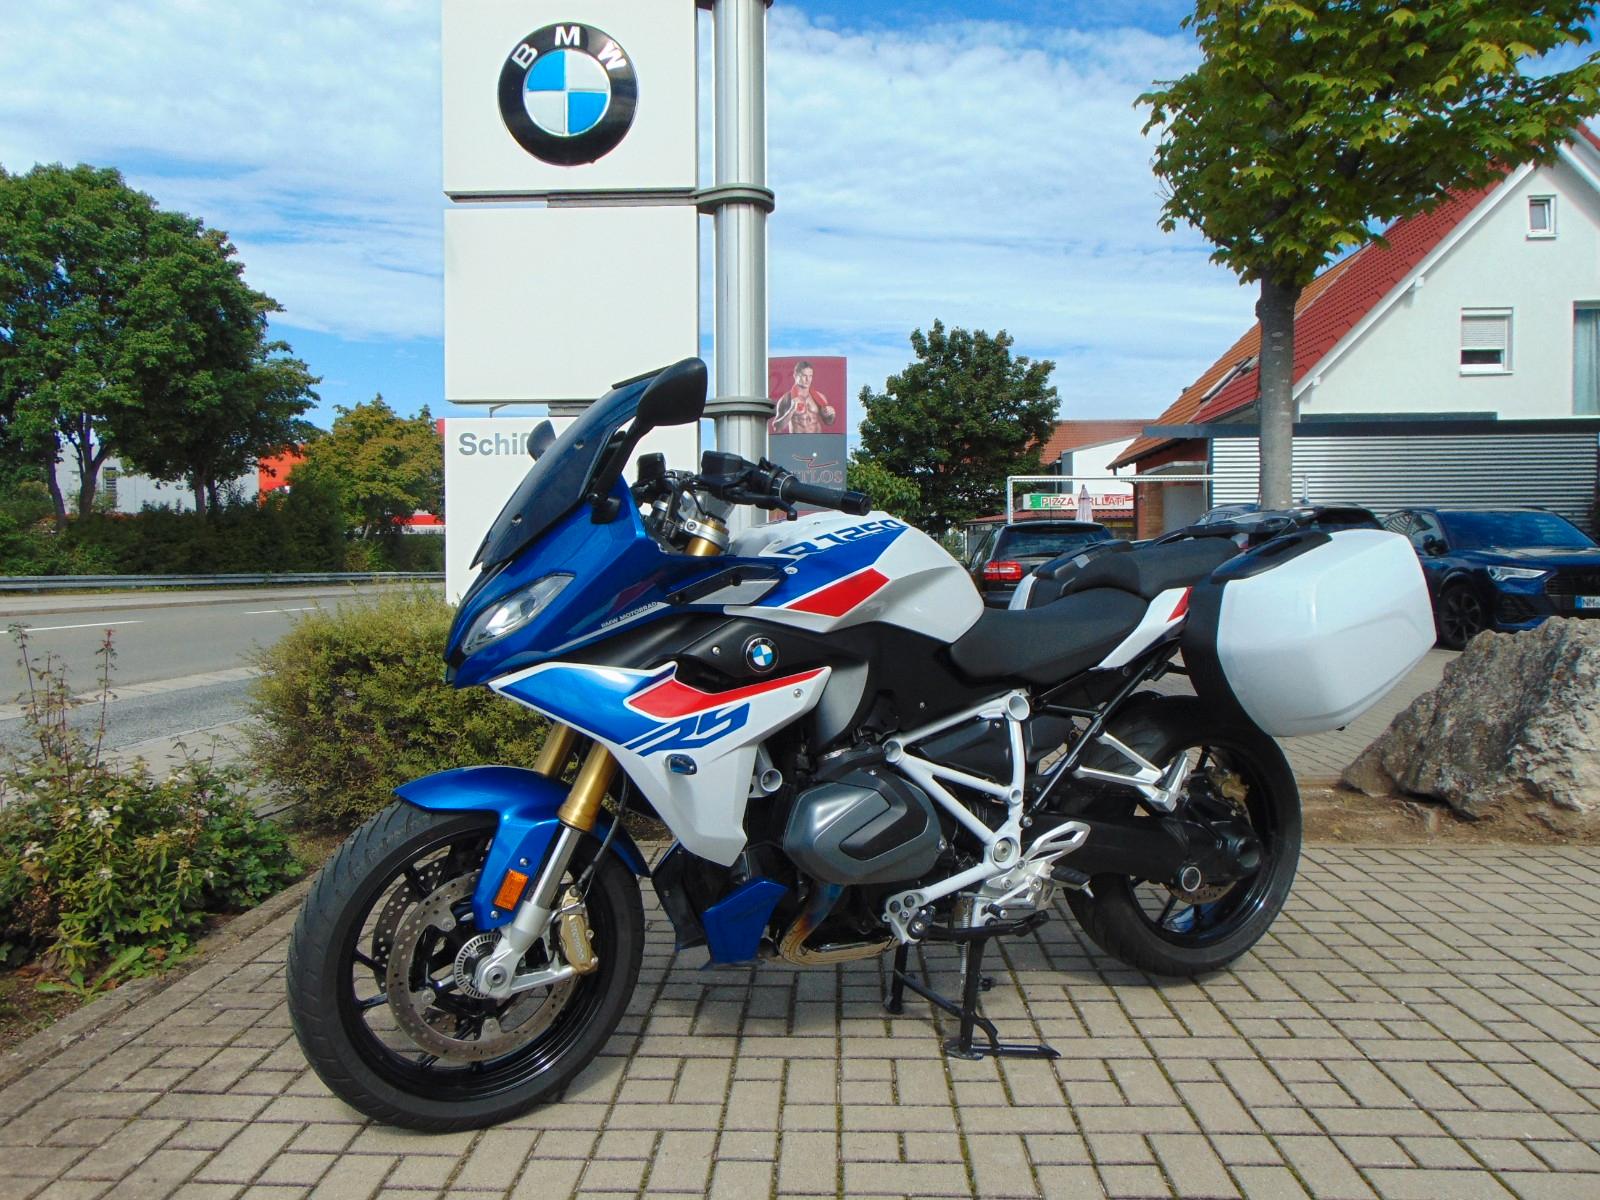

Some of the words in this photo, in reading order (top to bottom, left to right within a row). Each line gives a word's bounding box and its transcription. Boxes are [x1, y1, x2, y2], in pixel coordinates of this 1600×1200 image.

[511, 25, 627, 71] BMW
[1041, 496, 1075, 506] PIZZA
[774, 541, 825, 556] R
[814, 519, 907, 545] 1250
[619, 601, 658, 620] MOTORRAD
[624, 702, 750, 757] RS
